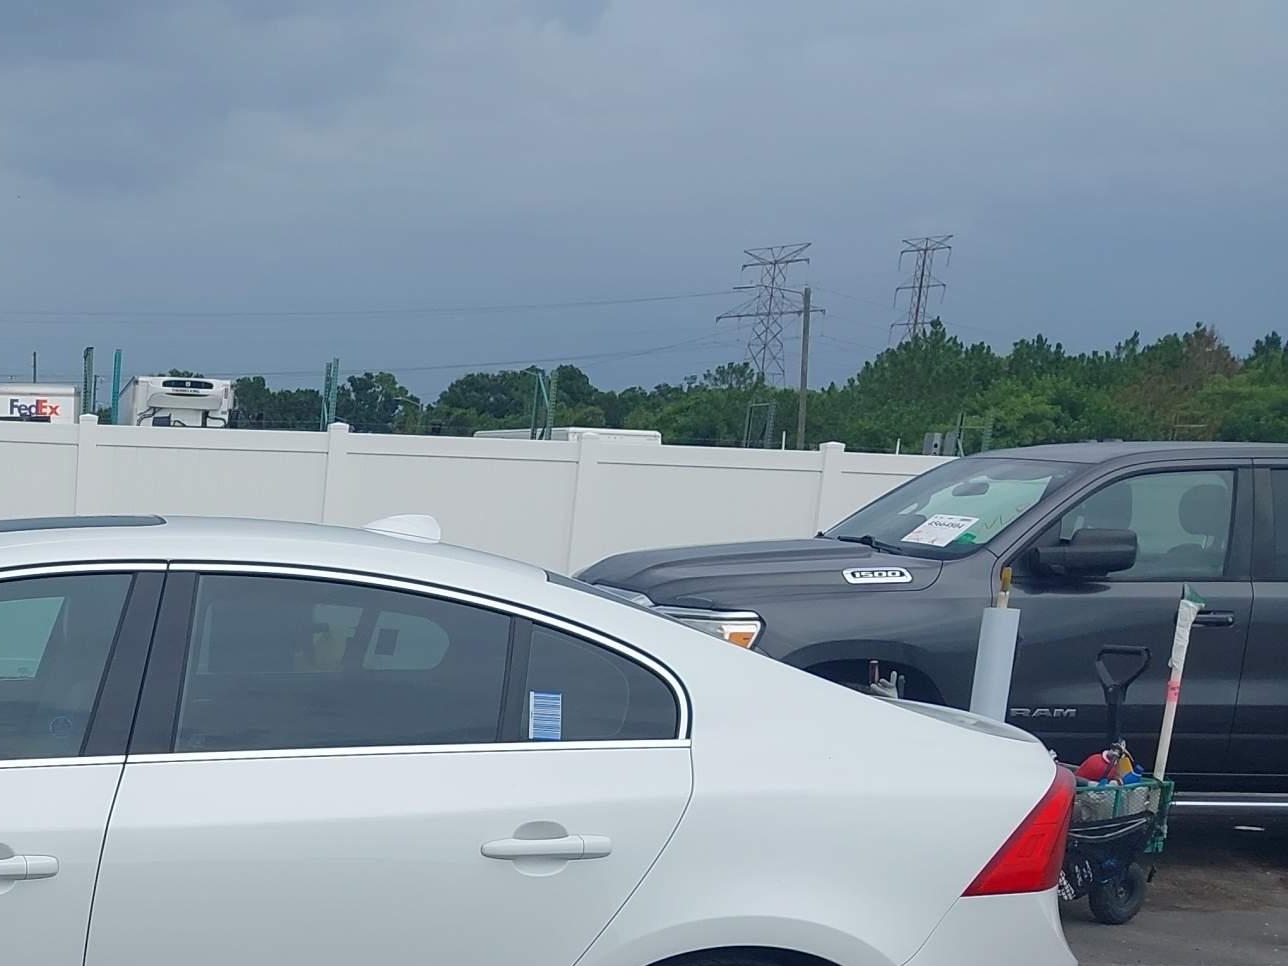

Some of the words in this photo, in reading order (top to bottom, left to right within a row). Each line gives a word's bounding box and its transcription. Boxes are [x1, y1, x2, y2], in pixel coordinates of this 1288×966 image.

[9, 398, 61, 417] FedEx
[853, 570, 902, 579] 1500
[1010, 707, 1077, 718] RAM
